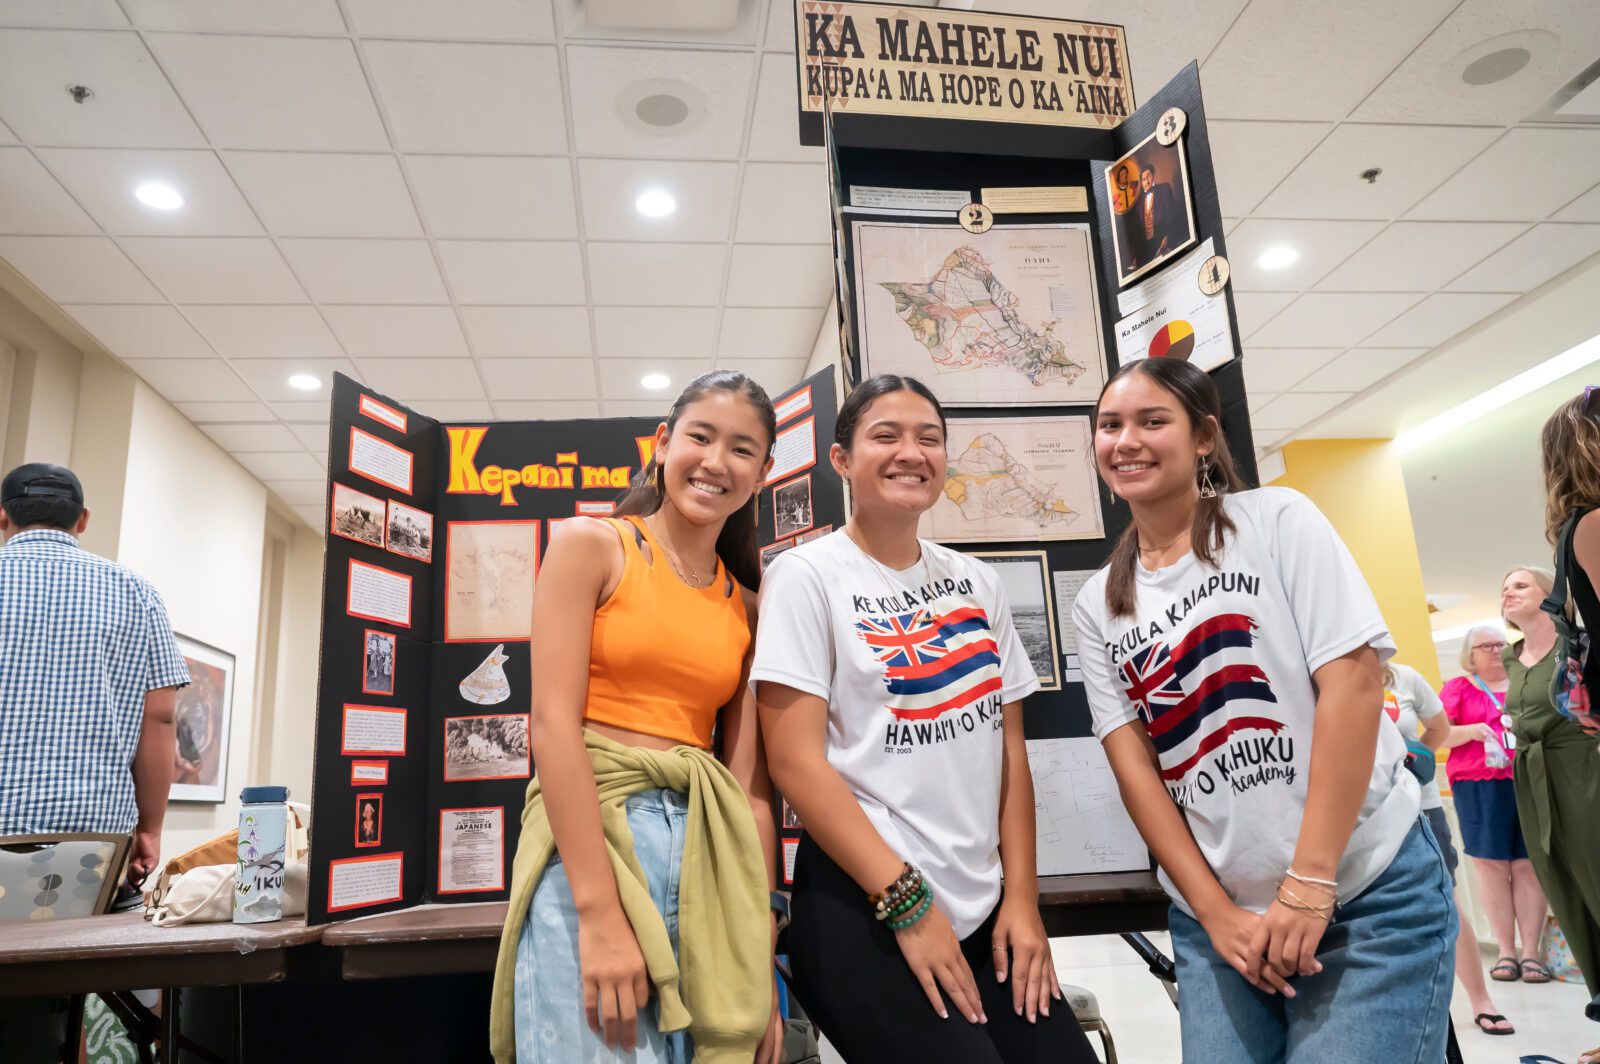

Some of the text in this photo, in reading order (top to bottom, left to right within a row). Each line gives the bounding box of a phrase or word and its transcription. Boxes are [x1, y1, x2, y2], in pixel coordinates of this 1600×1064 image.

[805, 13, 1122, 79] KA MAHELE NUI
[898, 70, 935, 103] MA
[940, 73, 1002, 108] HOPE
[1008, 78, 1025, 109] O
[1030, 80, 1064, 112] KA
[1163, 115, 1177, 137] 3
[968, 209, 984, 226] 2
[1207, 263, 1221, 283] 4
[1121, 306, 1167, 339] Ka Mahele Nui
[446, 426, 578, 506] Kepanī
[580, 466, 632, 490] ma
[852, 594, 876, 613] KE
[875, 590, 920, 614] KULA
[1119, 621, 1163, 658] KULA
[1165, 572, 1260, 627] KAIAPUNI
[884, 746, 912, 755] EST. 2003
[1213, 736, 1294, 782] KHUKU
[1231, 764, 1297, 797] Academy
[454, 823, 492, 831] JAPANESE
